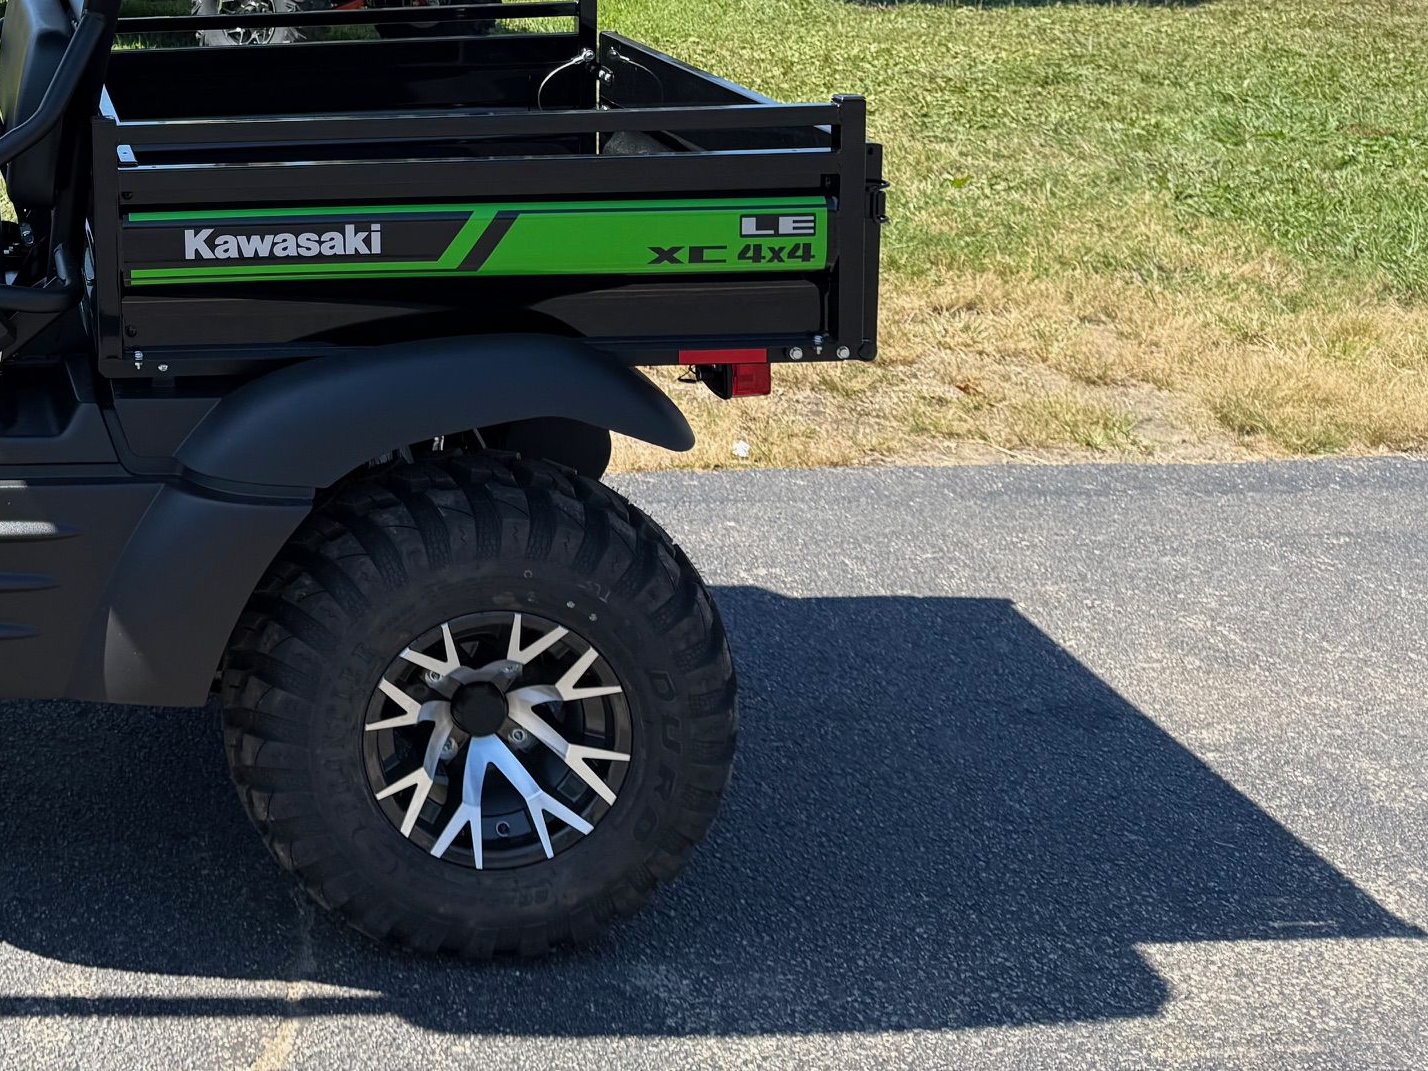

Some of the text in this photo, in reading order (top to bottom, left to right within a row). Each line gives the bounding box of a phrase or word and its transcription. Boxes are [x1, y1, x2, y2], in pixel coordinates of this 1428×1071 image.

[741, 216, 815, 236] LE
[184, 223, 382, 260] Kawasaki
[646, 242, 816, 265] XC 4x4
